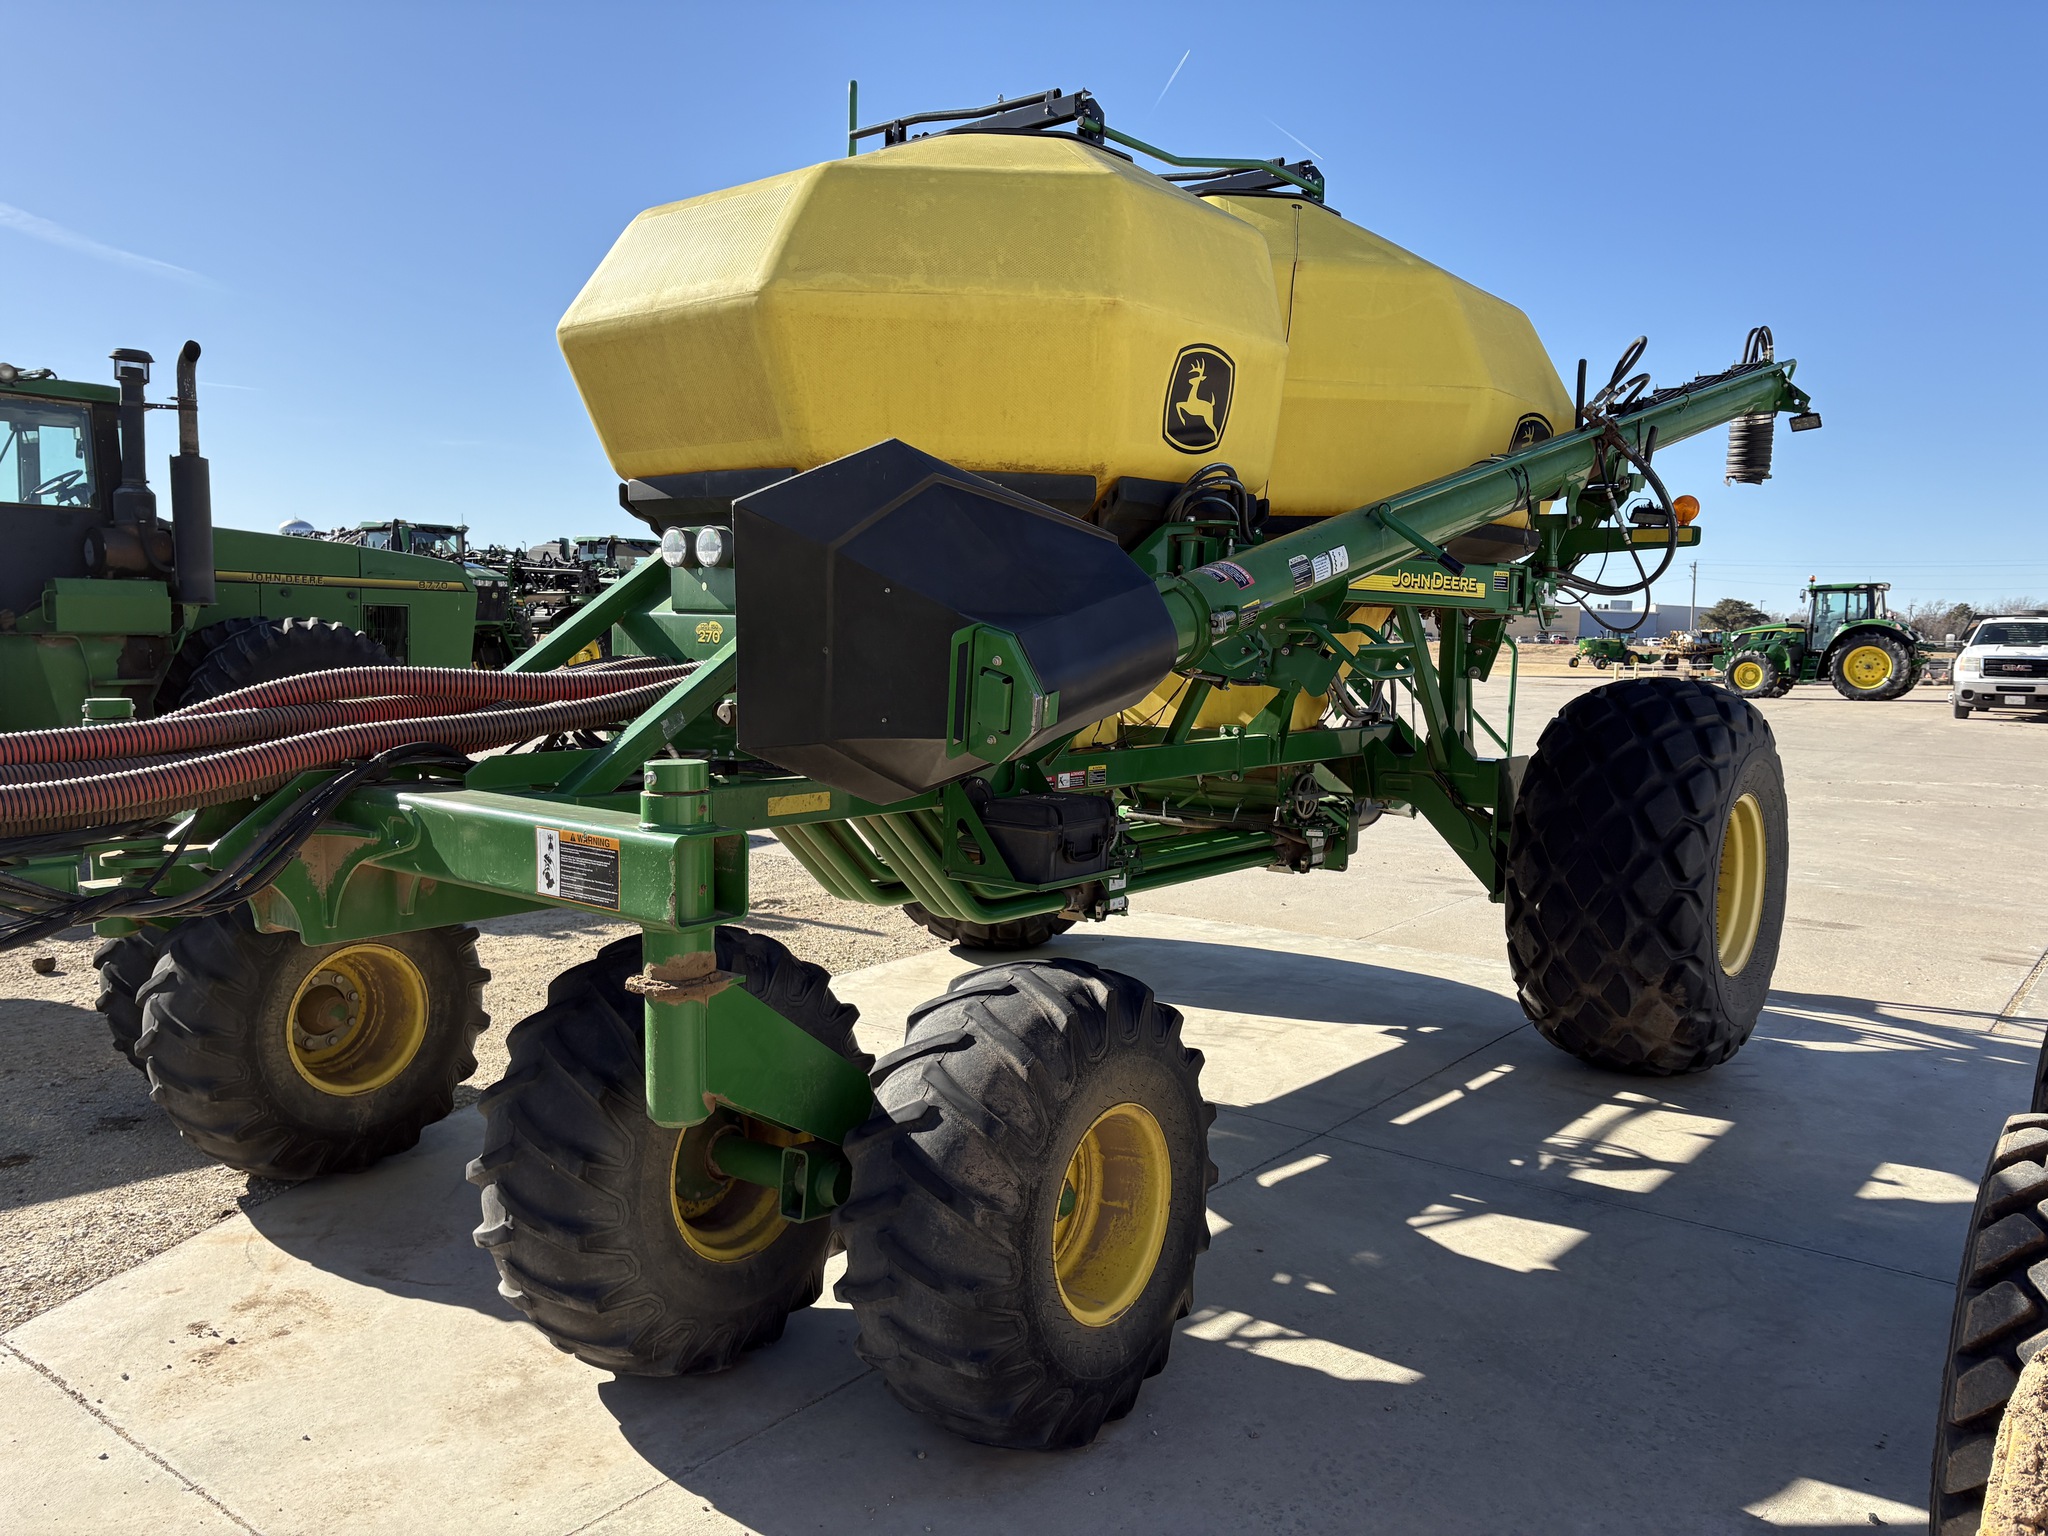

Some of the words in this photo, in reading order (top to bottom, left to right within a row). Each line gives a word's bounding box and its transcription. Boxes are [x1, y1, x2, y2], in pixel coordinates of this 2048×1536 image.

[247, 573, 281, 583] JOHN
[285, 575, 324, 585] DEERE
[418, 581, 448, 590] 8770
[1392, 569, 1431, 589] JOHN
[1433, 572, 1477, 592] DEERE
[697, 630, 720, 643] 270
[577, 834, 610, 847] WARNING
